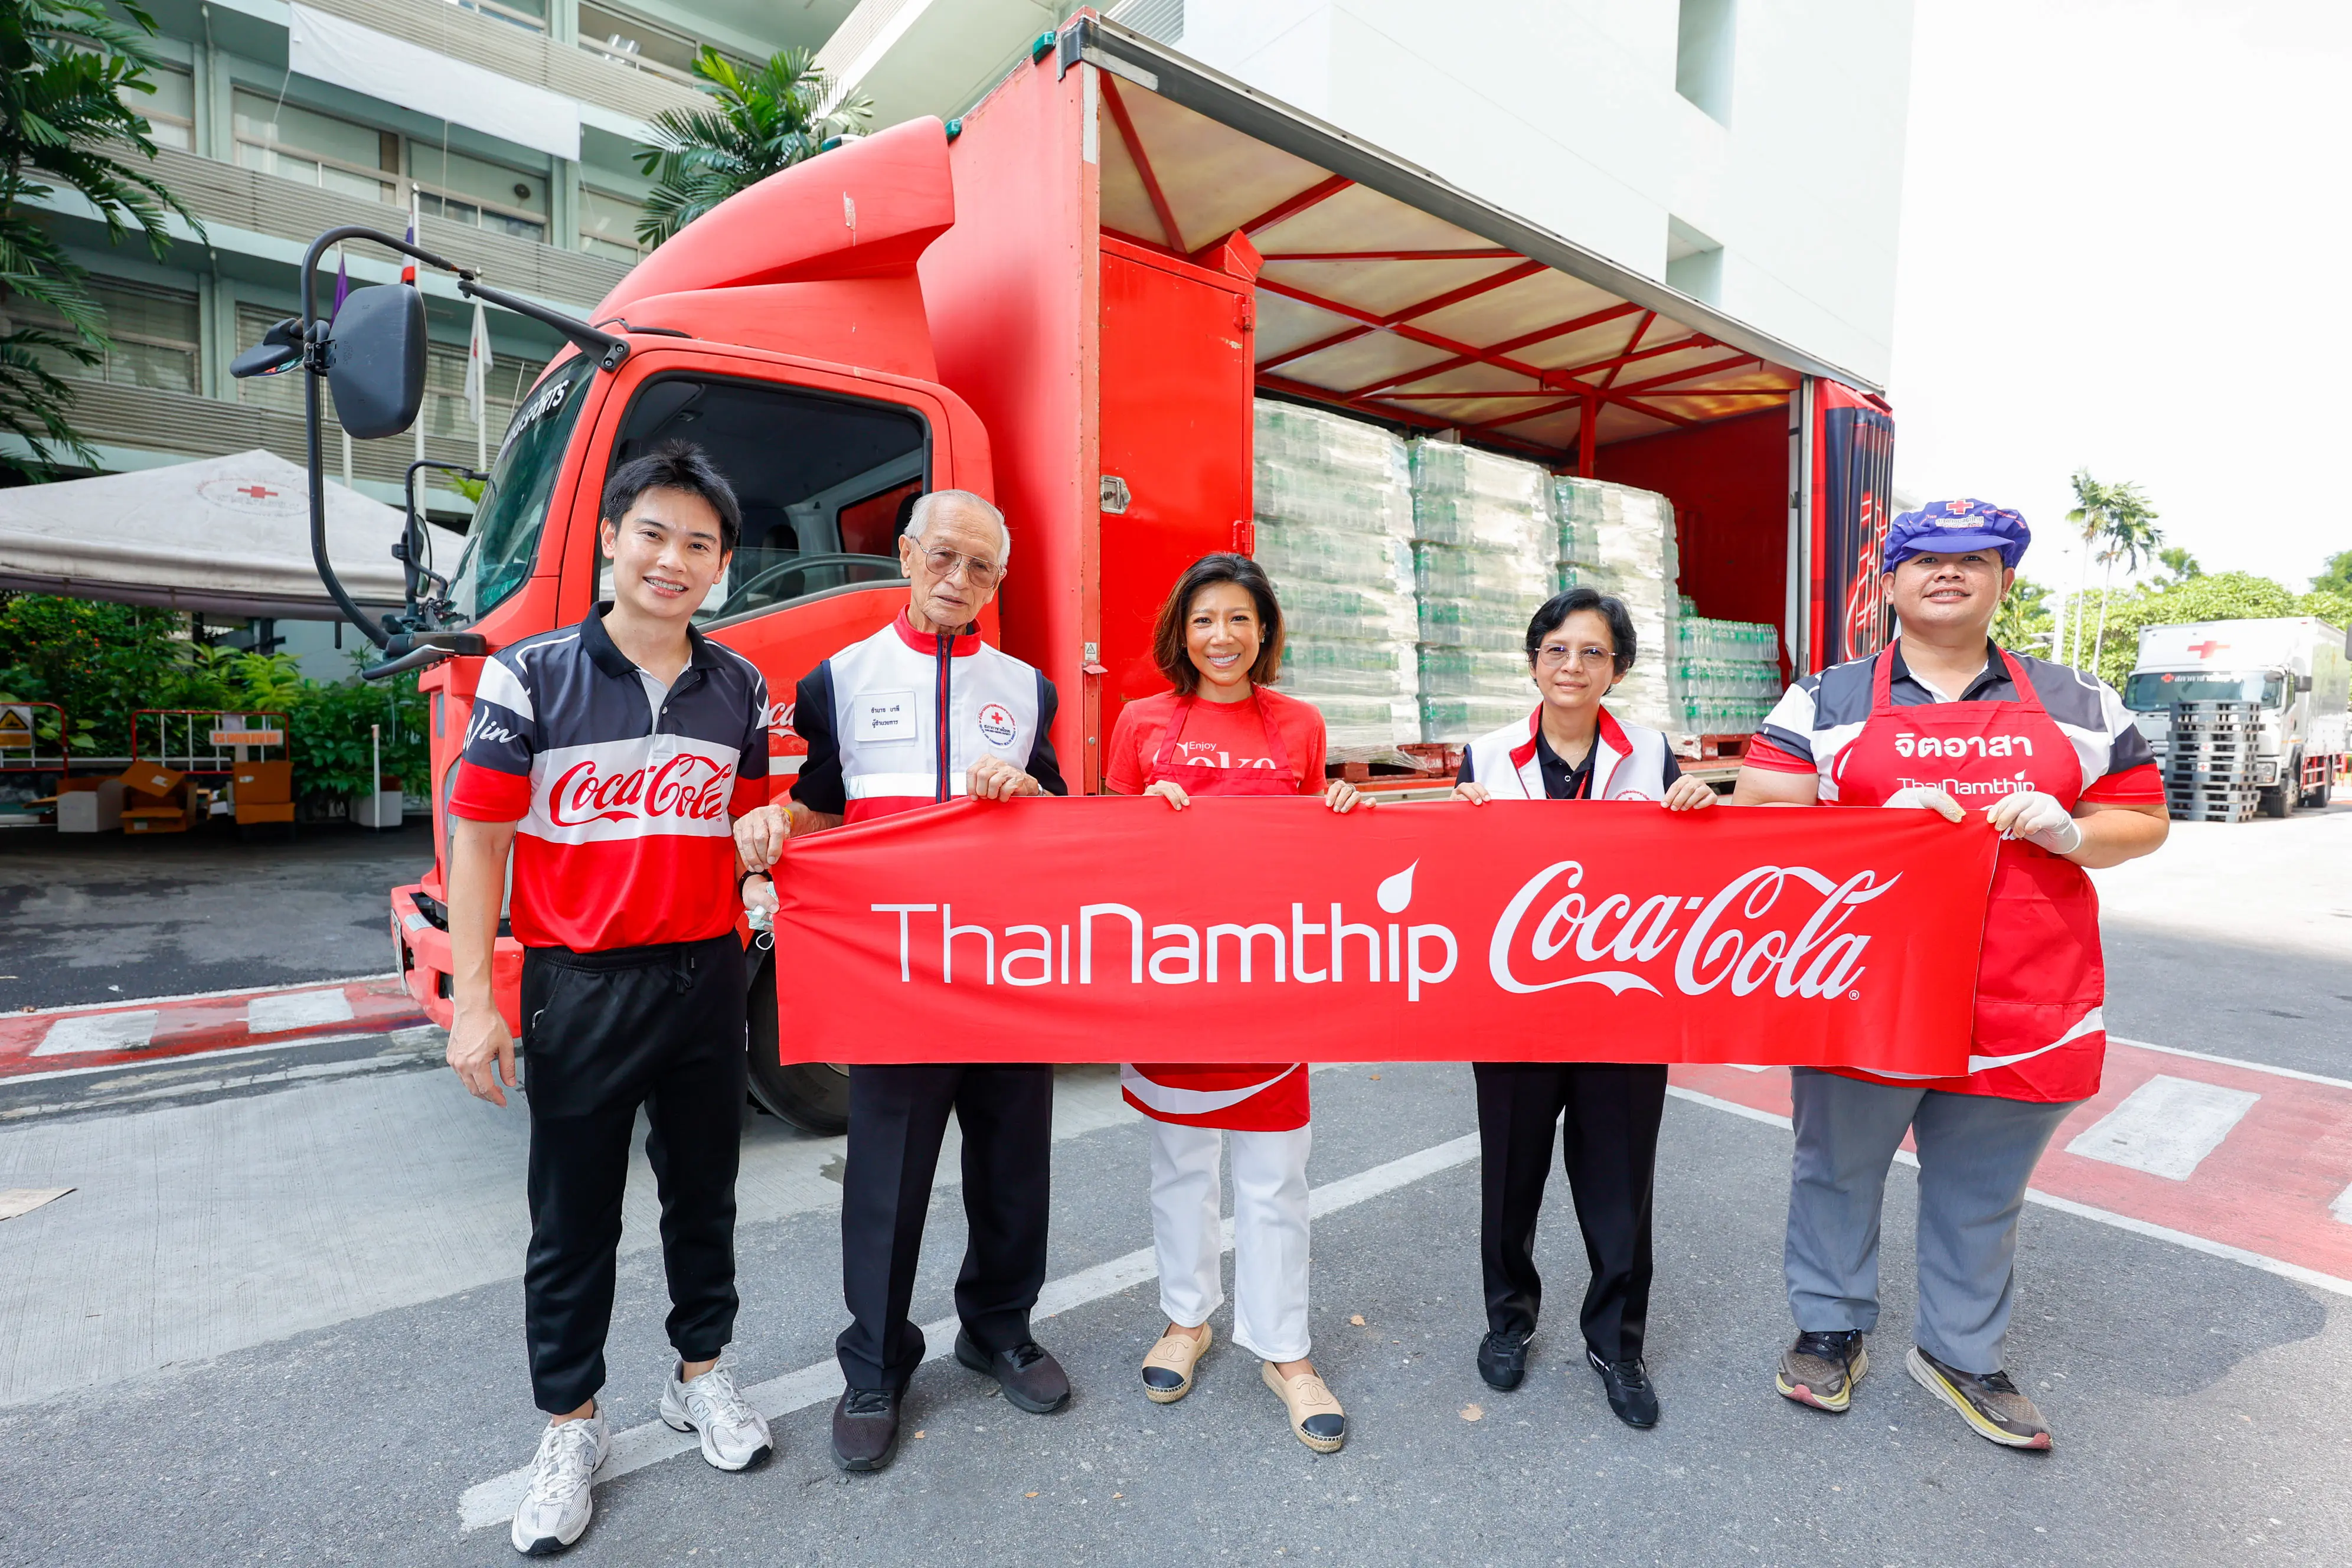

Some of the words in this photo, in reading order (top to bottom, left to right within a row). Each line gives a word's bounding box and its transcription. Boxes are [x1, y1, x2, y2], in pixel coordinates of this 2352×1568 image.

[1189, 741, 1217, 751] Enjoy
[1894, 733, 2033, 757] จิตอาสา
[871, 858, 1458, 1002] ThaiNamthip
[1489, 860, 1904, 999] Coca-Cola
